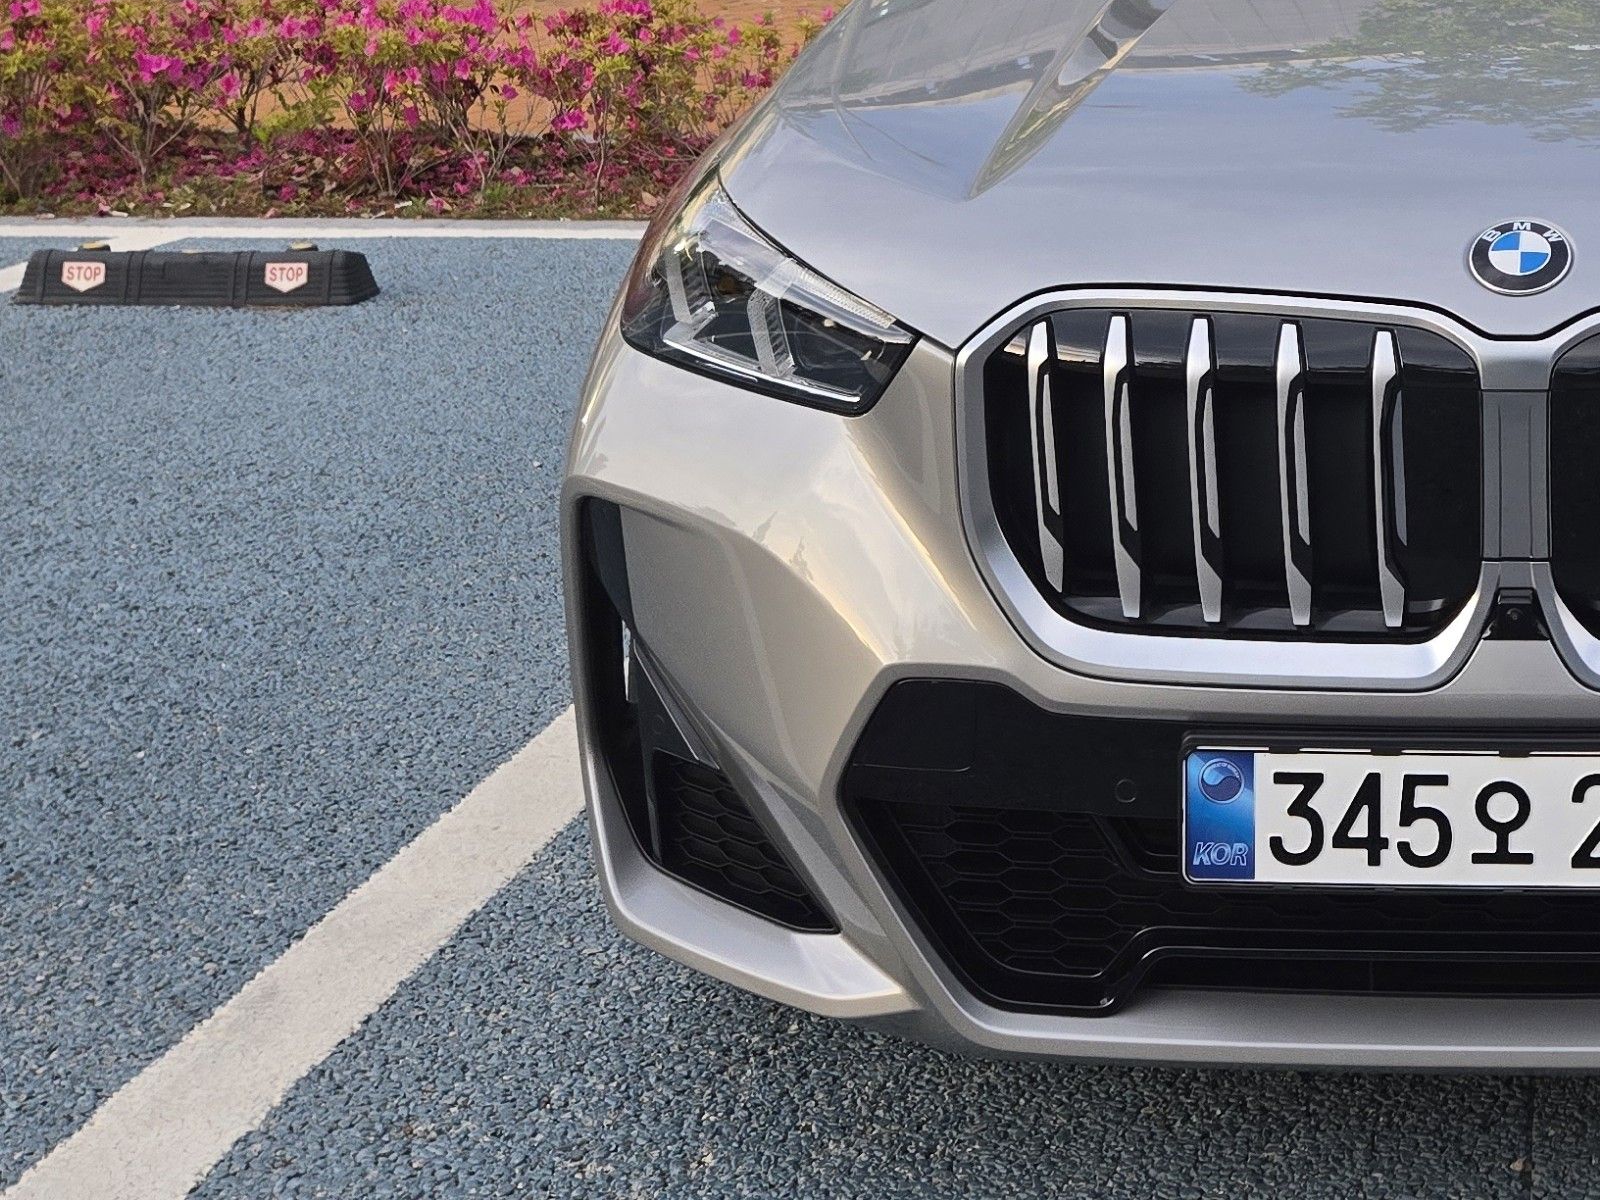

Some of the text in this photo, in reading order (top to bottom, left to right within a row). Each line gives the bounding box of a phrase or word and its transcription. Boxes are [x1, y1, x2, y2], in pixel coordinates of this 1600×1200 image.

[1481, 222, 1563, 243] BMW
[66, 265, 102, 282] STOP
[269, 266, 304, 282] STOP
[1269, 771, 1534, 868] 345오
[1192, 841, 1249, 866] KOR
